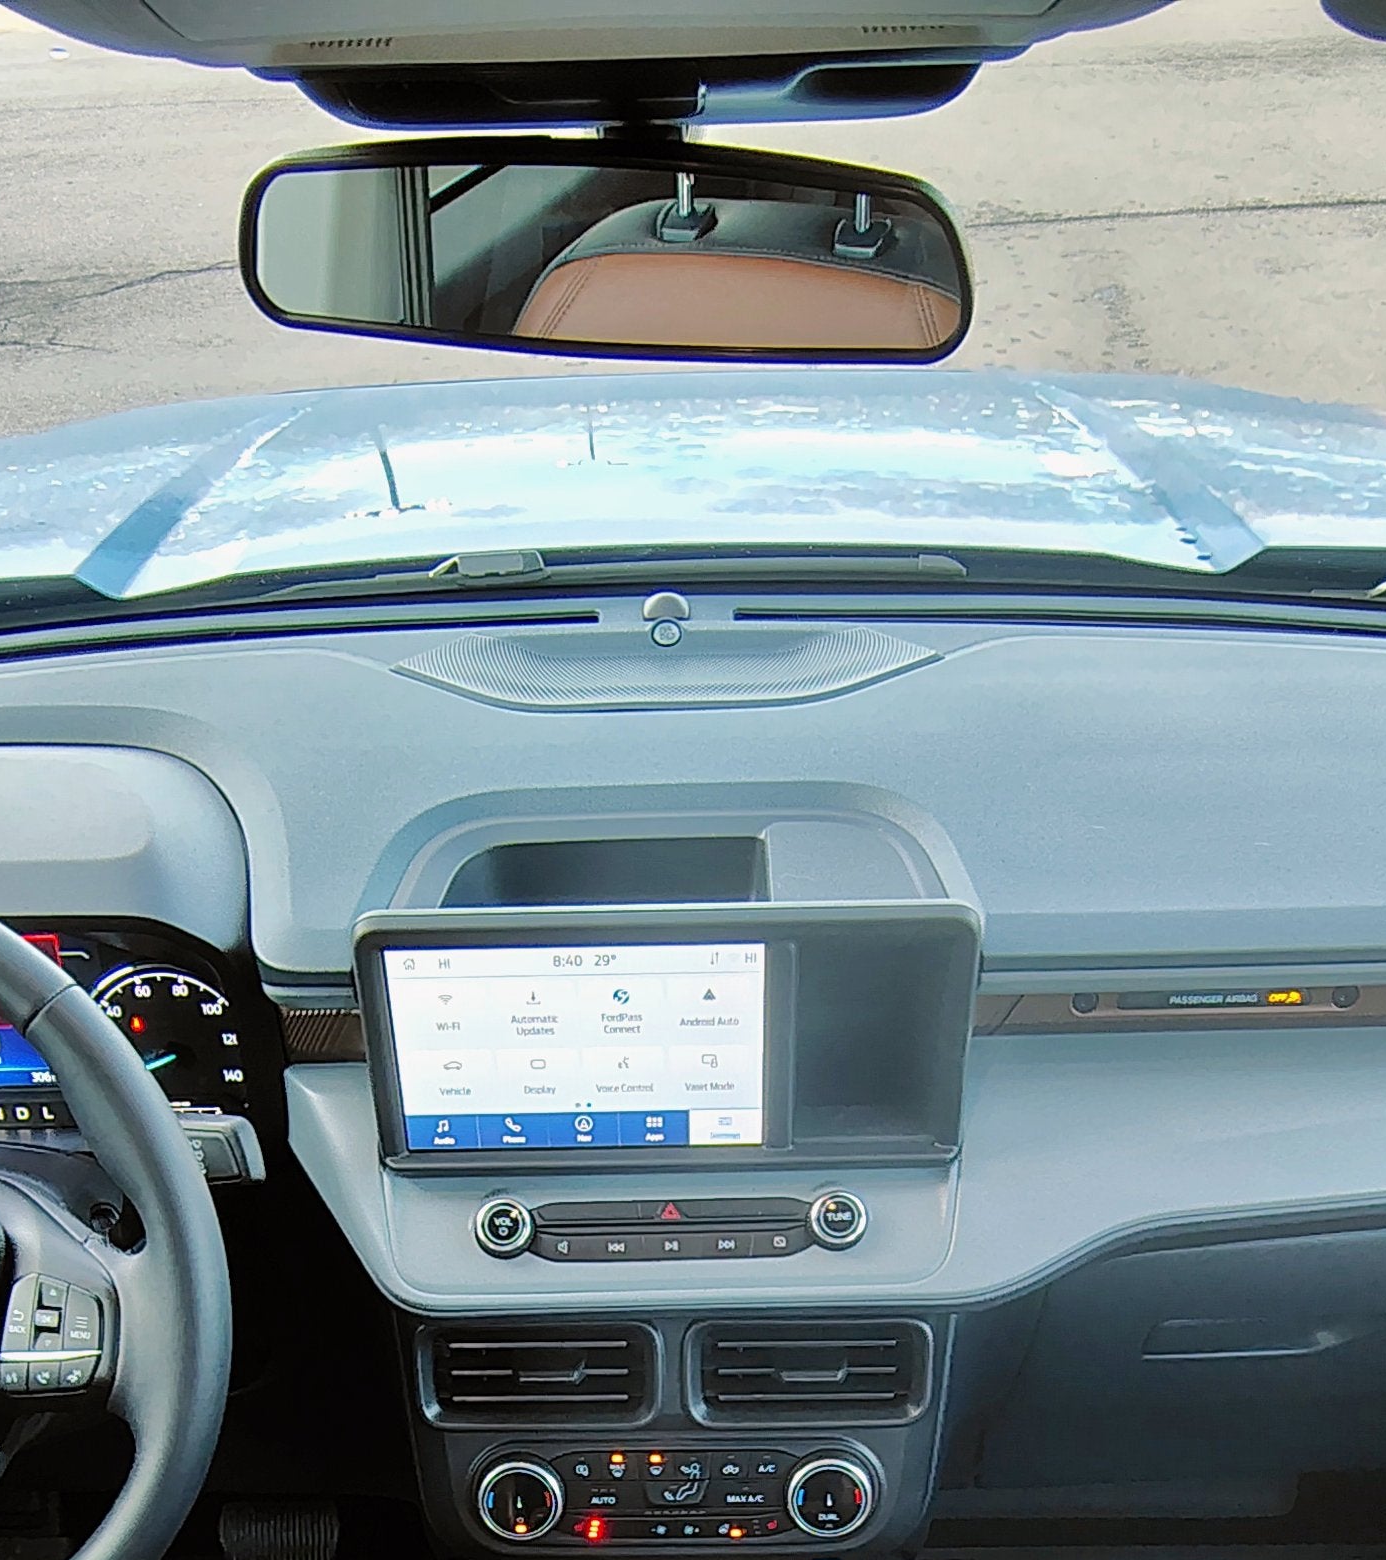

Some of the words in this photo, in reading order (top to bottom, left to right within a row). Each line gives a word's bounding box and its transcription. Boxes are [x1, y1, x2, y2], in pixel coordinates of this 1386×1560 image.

[553, 955, 583, 967] 8:40
[745, 952, 757, 963] HI
[439, 958, 450, 969] HI
[1169, 994, 1223, 1005] PASSENGER
[201, 1003, 223, 1016] 100
[511, 1015, 558, 1024] Automatic
[601, 1013, 643, 1022] FordPass
[679, 1018, 715, 1026] Android
[717, 1017, 739, 1026] Auto
[516, 1027, 555, 1036] Updates
[604, 1025, 641, 1034] Connect
[223, 1069, 244, 1082] 140
[524, 1085, 556, 1096] Display
[596, 1084, 619, 1093] Voice
[621, 1083, 654, 1092] Control
[710, 1081, 734, 1090] Mode
[439, 1087, 471, 1096] Vehicle
[15, 1106, 30, 1120] D
[42, 1106, 55, 1120] L
[826, 1211, 852, 1221] TUNE
[493, 1217, 513, 1227] VOL
[758, 1464, 776, 1473] A/C
[590, 1496, 616, 1504] AUTO
[726, 1494, 747, 1503] MAX
[747, 1494, 765, 1503] A/C
